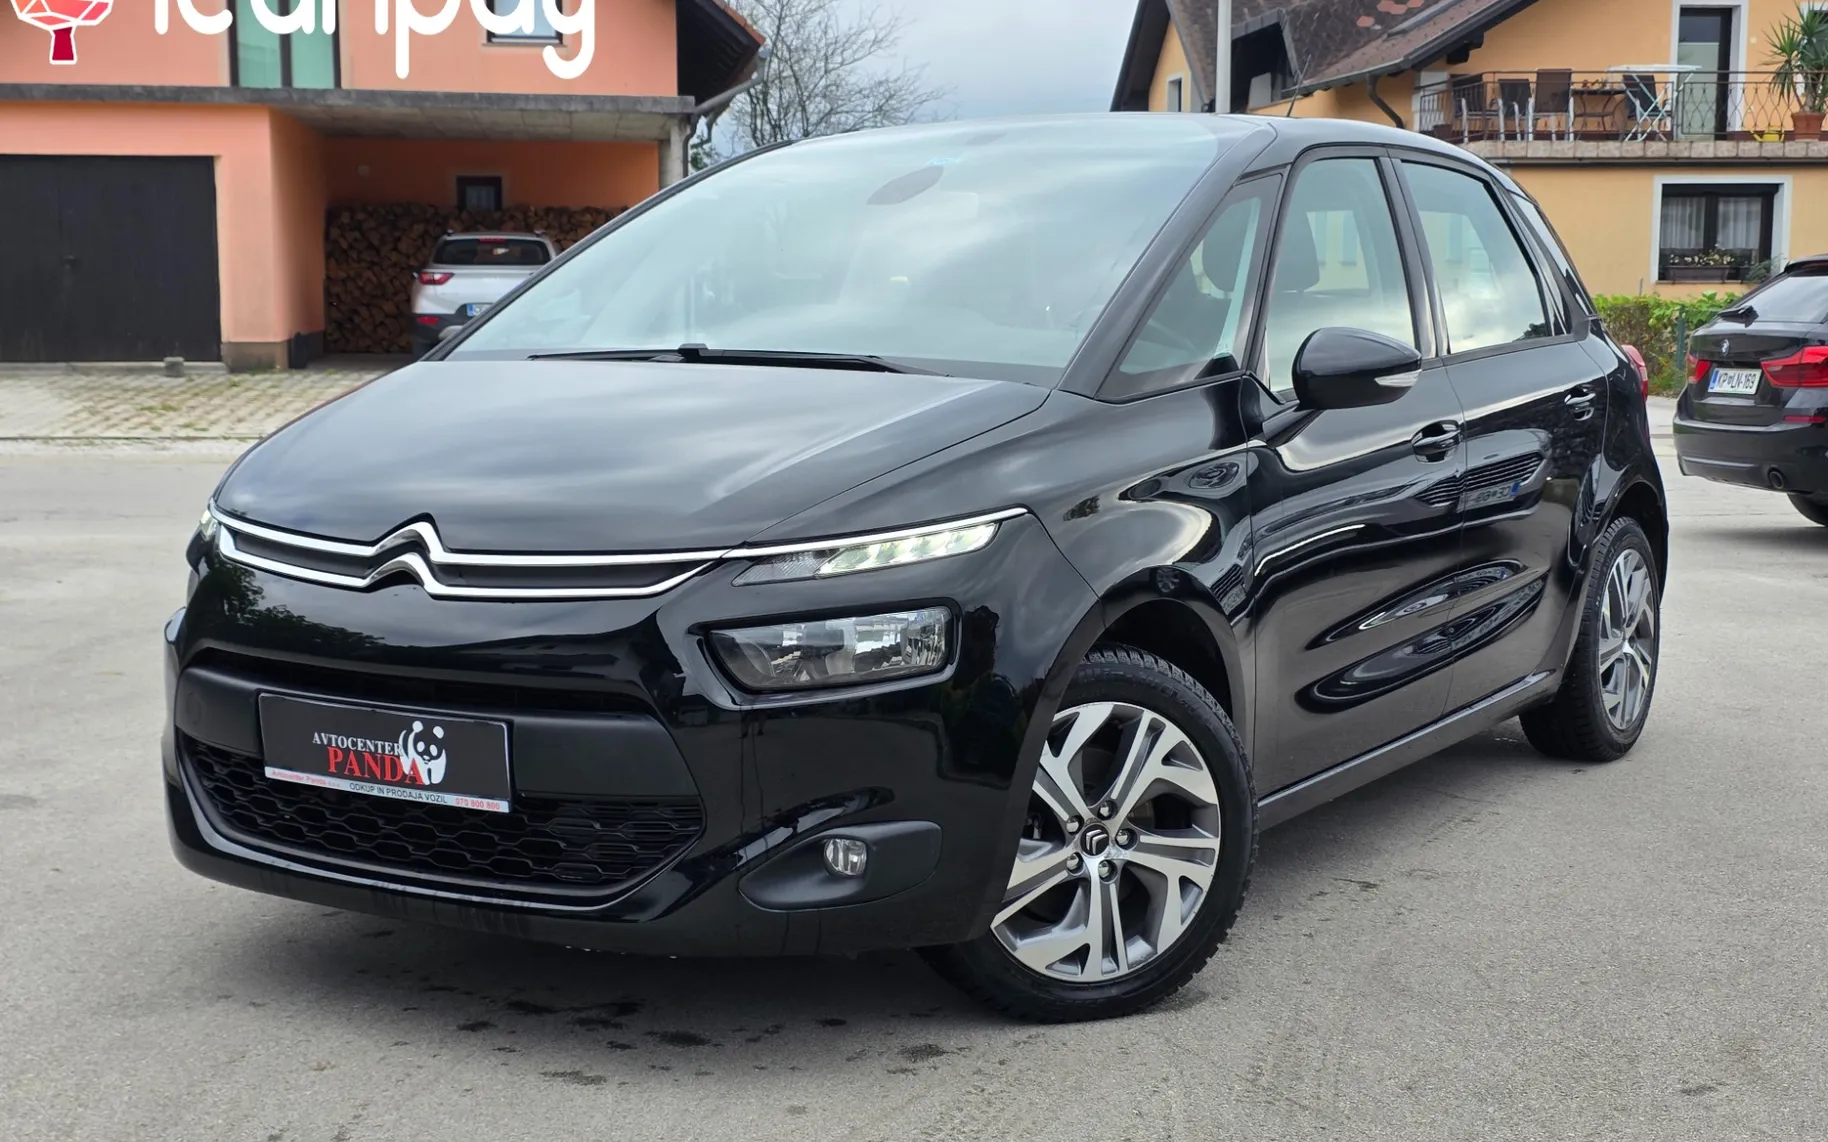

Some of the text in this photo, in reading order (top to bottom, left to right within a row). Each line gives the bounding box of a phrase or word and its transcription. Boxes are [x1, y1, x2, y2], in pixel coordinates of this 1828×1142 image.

[312, 732, 404, 757] AVTOCENTER
[327, 745, 425, 785] PANDA
[349, 782, 375, 794] ODKUP
[376, 786, 385, 795] IN
[386, 787, 424, 801] PRODAJA
[425, 793, 448, 804] VOZIL
